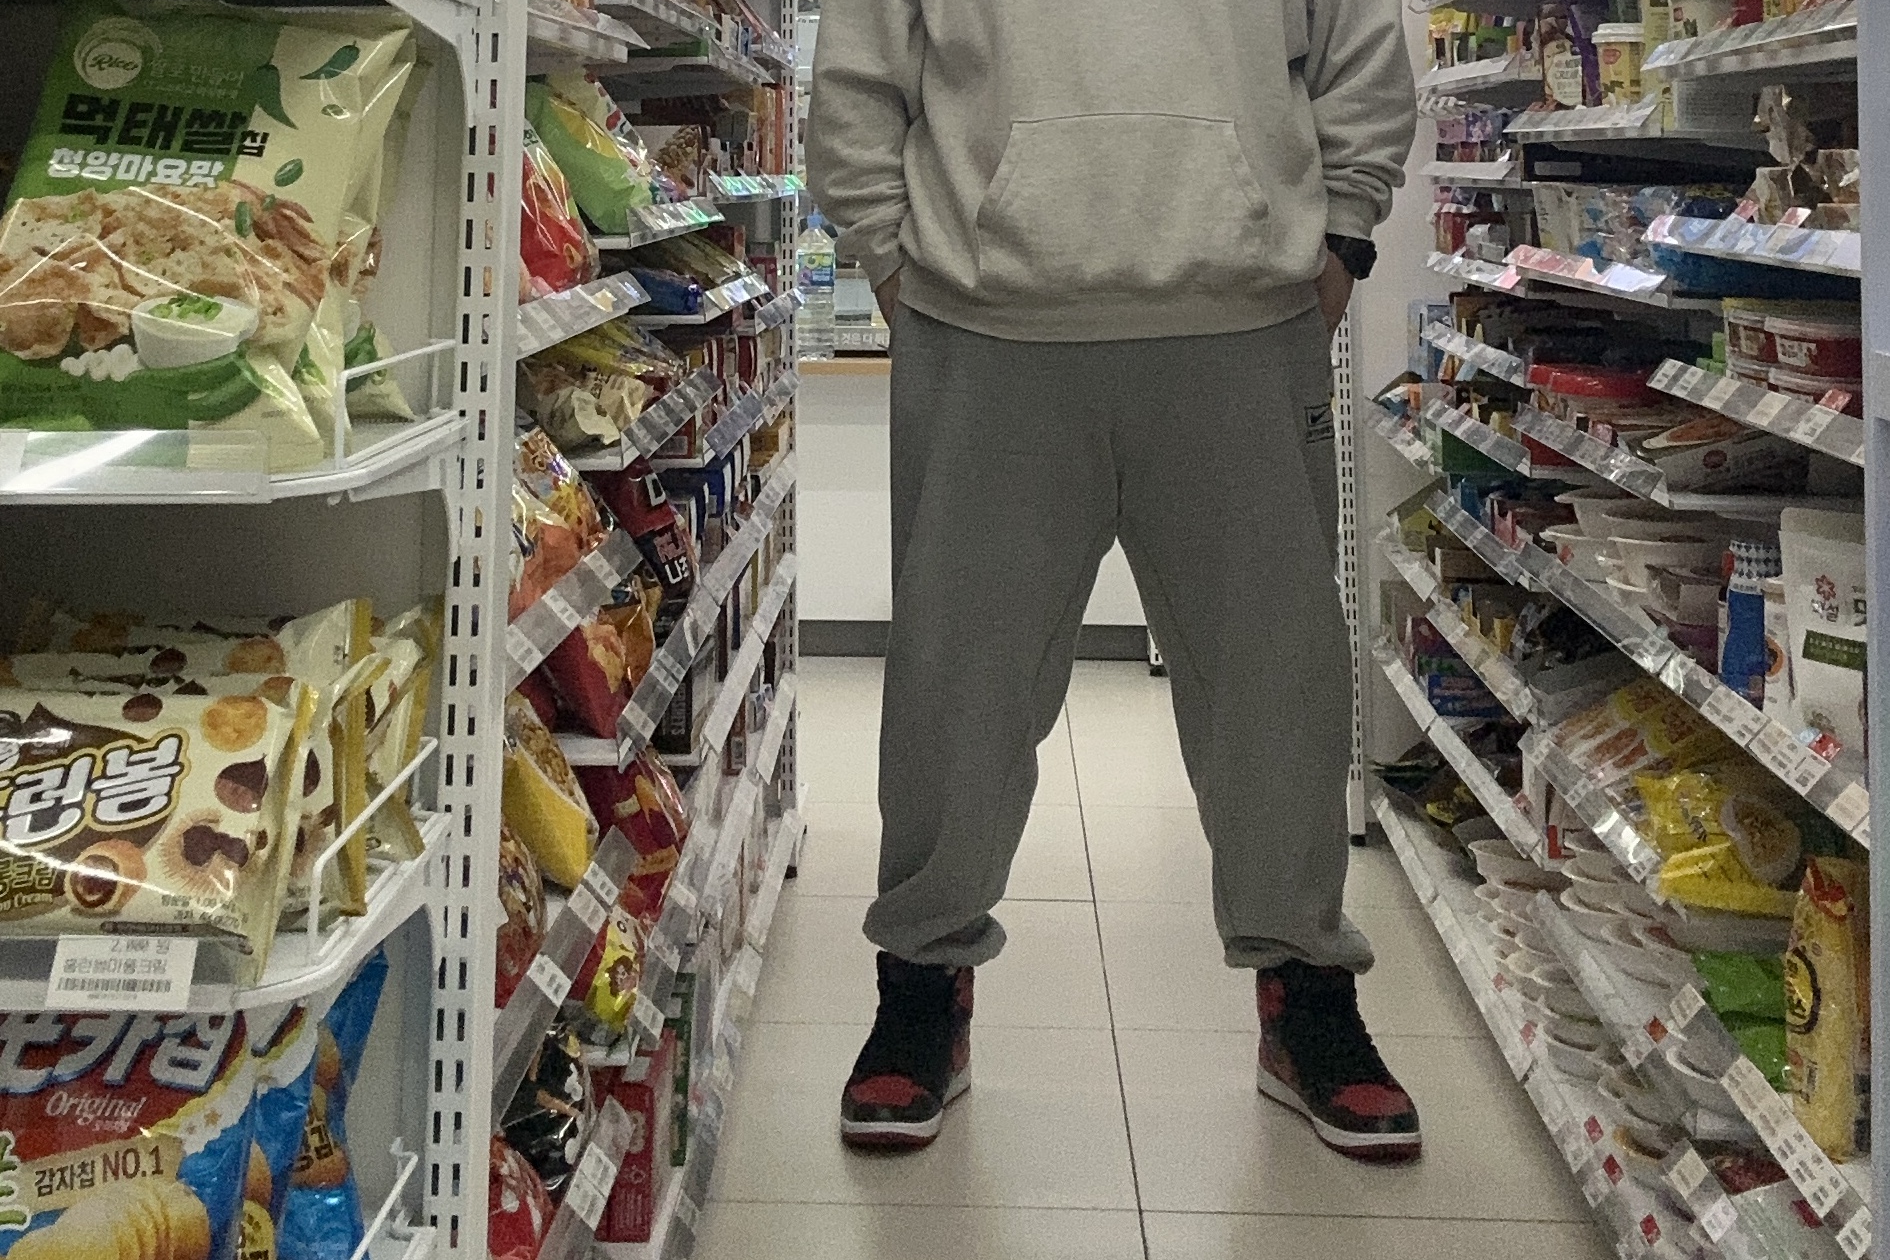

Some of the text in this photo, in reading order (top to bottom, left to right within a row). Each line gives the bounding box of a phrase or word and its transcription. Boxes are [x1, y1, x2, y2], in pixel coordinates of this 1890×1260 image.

[48, 148, 225, 188] 청양마요맛
[0, 736, 184, 846] 런볼
[46, 1091, 147, 1126] Original
[34, 1160, 96, 1198] 감자칩
[101, 1145, 164, 1183] NO.1
